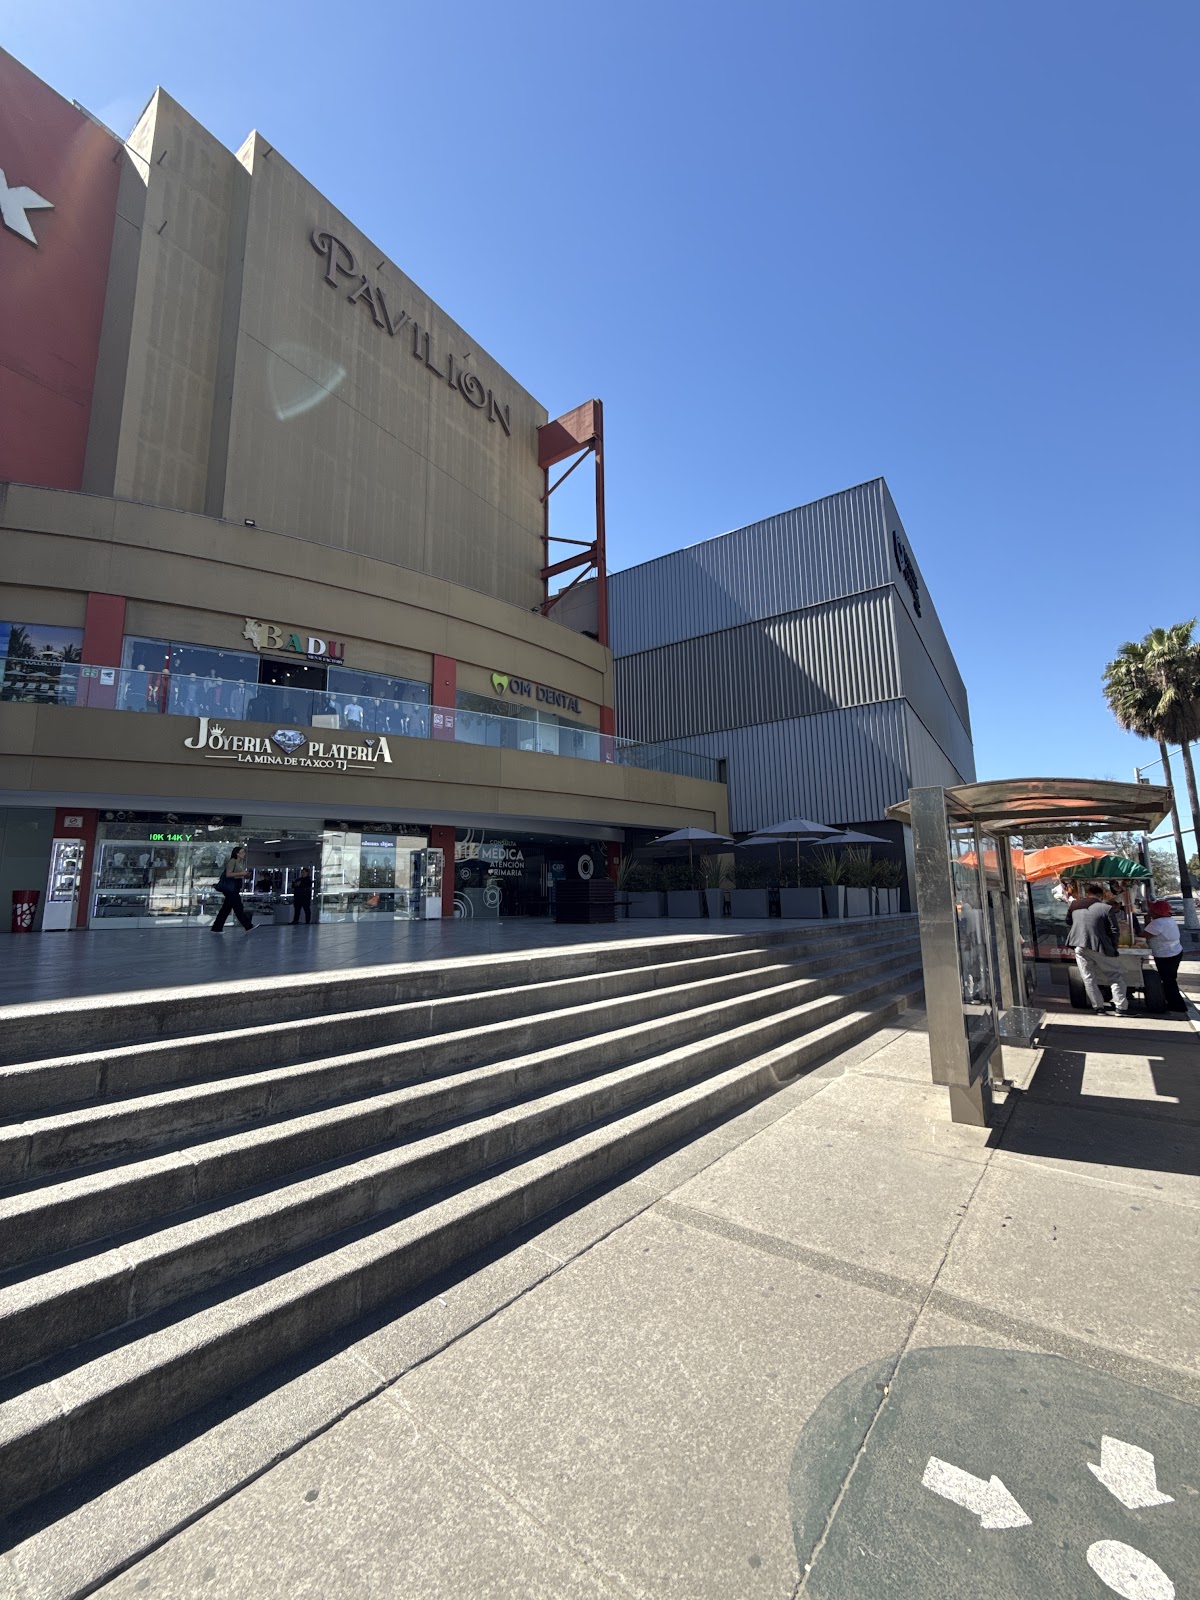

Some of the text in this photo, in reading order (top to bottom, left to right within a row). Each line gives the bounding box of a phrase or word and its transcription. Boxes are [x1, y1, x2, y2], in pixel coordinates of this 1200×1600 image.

[310, 227, 511, 436] PAVILION
[259, 622, 345, 658] BADU
[509, 679, 582, 714] OM DENTAL
[184, 717, 393, 763] JOYERIA PLATERIA
[237, 753, 348, 771] LA MINA DE TAXCO TJ
[149, 833, 193, 842] 10K 14K Y
[490, 839, 517, 847] CONSULTA
[482, 845, 524, 861] MÉDICA
[490, 861, 525, 869] ATENCIÓN
